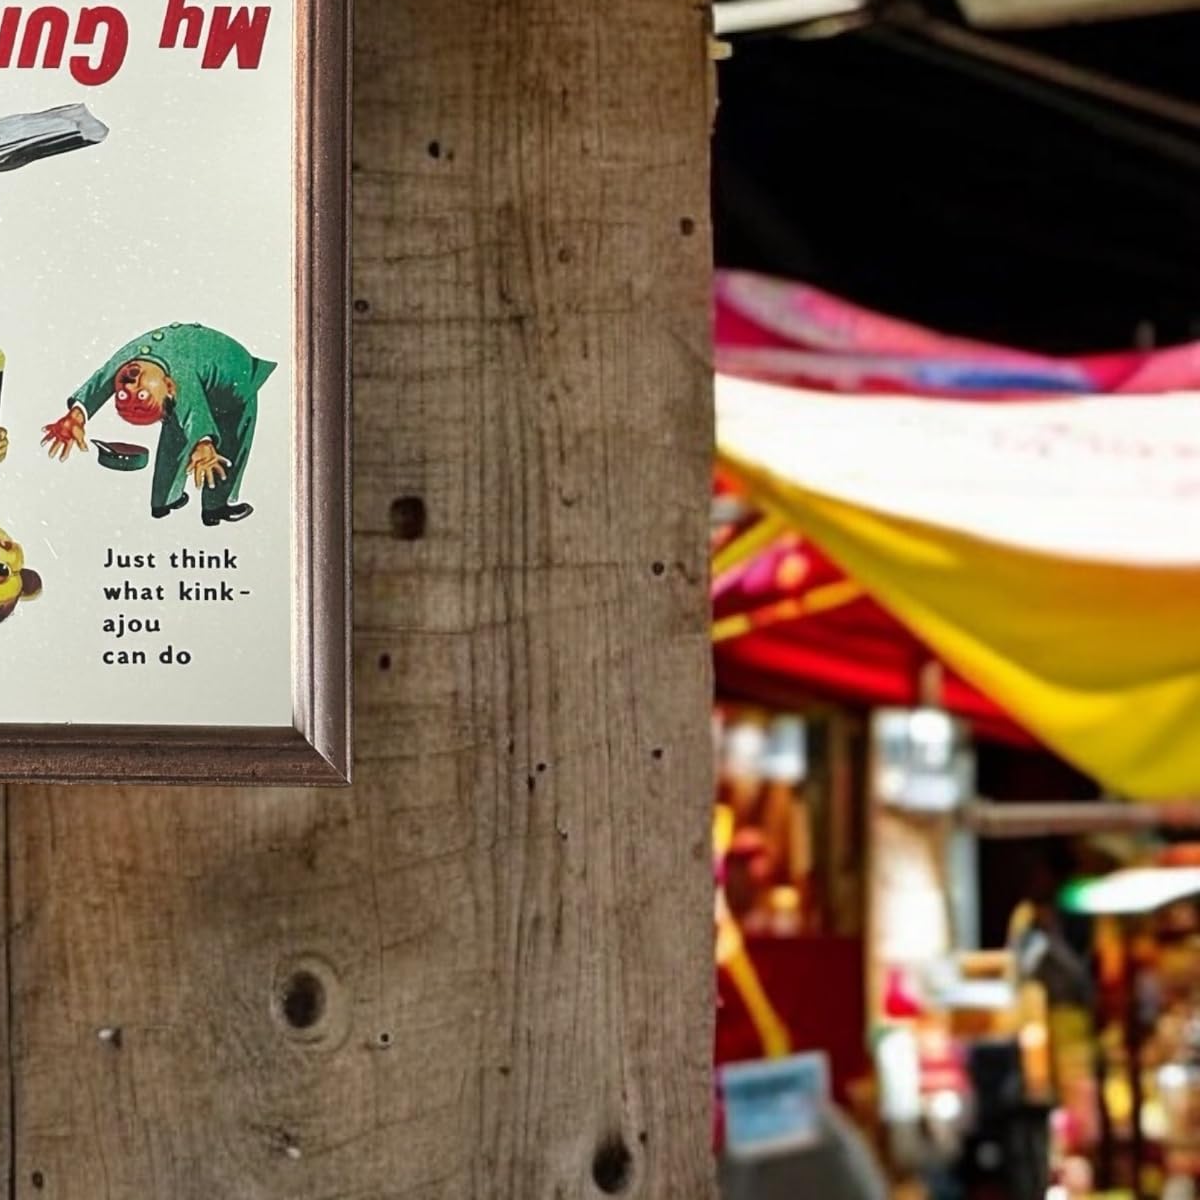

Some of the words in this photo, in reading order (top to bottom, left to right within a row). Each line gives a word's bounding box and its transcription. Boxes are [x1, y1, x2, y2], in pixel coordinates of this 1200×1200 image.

[104, 548, 156, 568] Just
[169, 548, 238, 569] think
[103, 580, 165, 601] what
[179, 580, 250, 601] kink-
[102, 614, 161, 638] ajou
[102, 651, 146, 665] can
[158, 645, 192, 665] do
